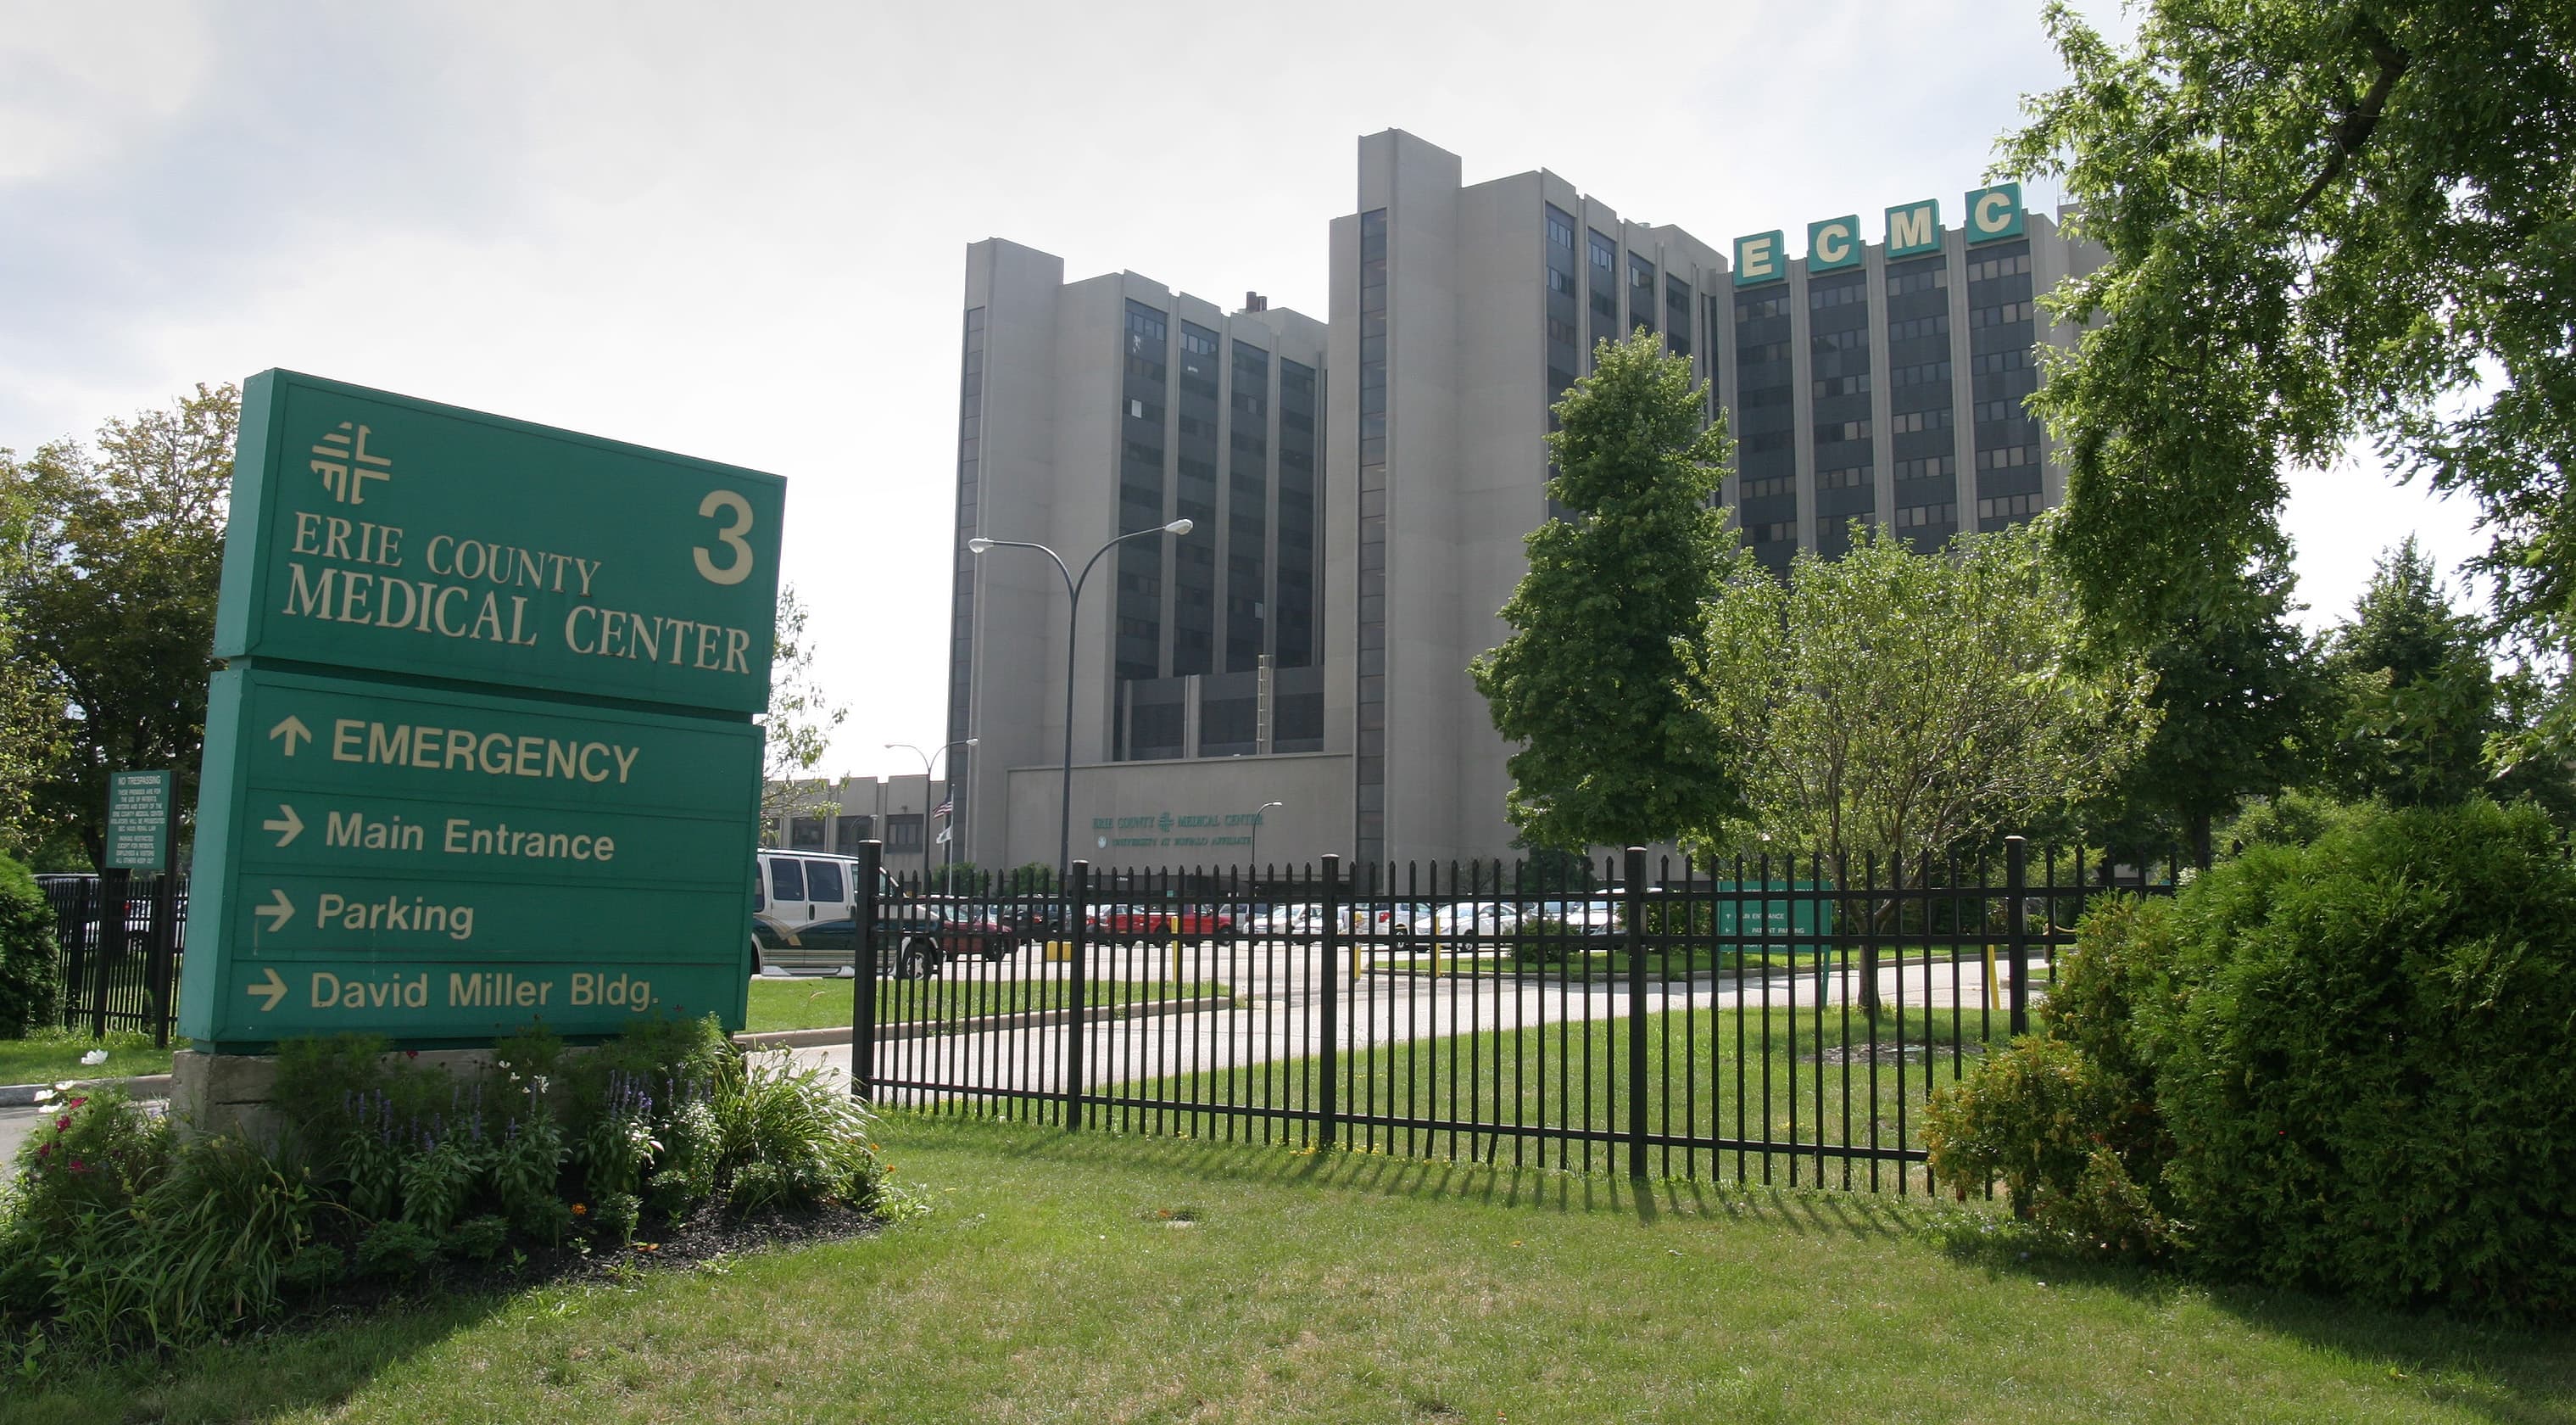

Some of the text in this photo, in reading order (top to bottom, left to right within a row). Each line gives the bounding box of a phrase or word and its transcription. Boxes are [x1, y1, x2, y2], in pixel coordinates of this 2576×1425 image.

[1741, 192, 2013, 279] ECMC
[292, 511, 602, 598] ERIE COUNTY
[693, 489, 755, 585] 3
[282, 562, 752, 675] MEDICAL CENTER
[332, 718, 640, 785] EMERGENCY
[326, 811, 616, 862] Main Entrance
[1092, 814, 1263, 829] ERIE COUNTY MEDICAL CENTER
[316, 894, 475, 941] Parking
[309, 972, 661, 1013] David Miller Bldg.
